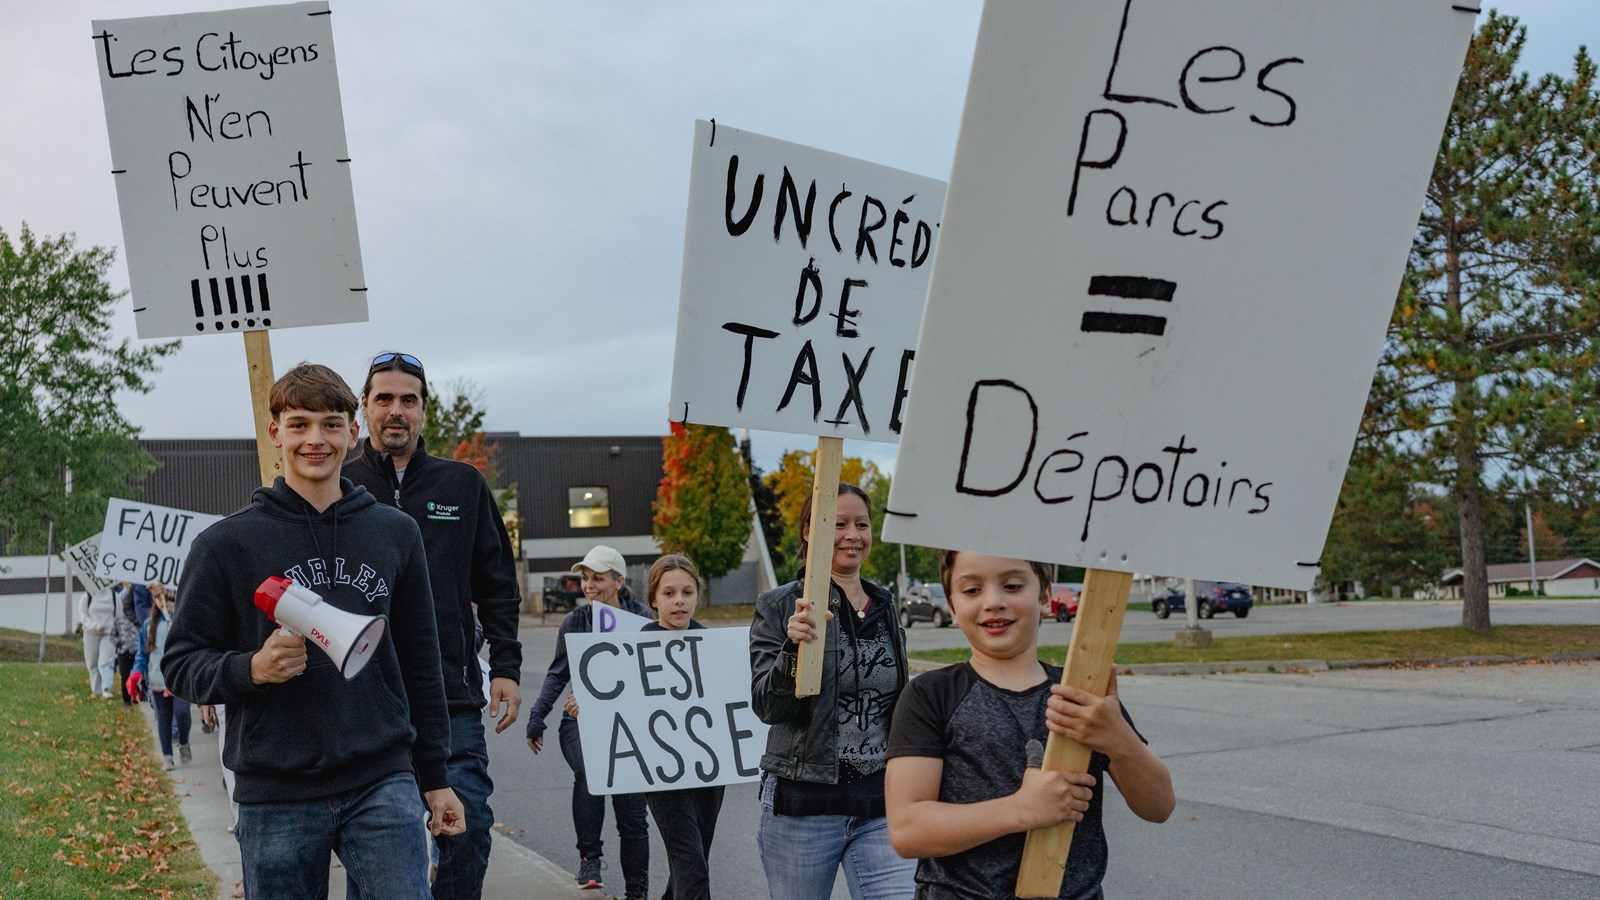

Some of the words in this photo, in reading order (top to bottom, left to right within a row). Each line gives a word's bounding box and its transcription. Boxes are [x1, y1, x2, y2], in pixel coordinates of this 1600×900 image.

[102, 30, 184, 78] Les
[196, 32, 318, 80] Citoyens
[1101, 0, 1304, 127] Les
[185, 93, 272, 143] N'en
[169, 151, 312, 211] Peuvent
[1067, 109, 1228, 240] Parcs
[200, 224, 269, 270] Plus
[793, 260, 869, 338] DE
[956, 379, 1274, 542] Dépotoirs
[118, 508, 194, 547] FAUT
[436, 504, 459, 512] Kruger
[70, 539, 98, 562] LES
[284, 557, 389, 603] URLEY
[579, 636, 704, 701] C'EST
[607, 701, 760, 789] ASSE
